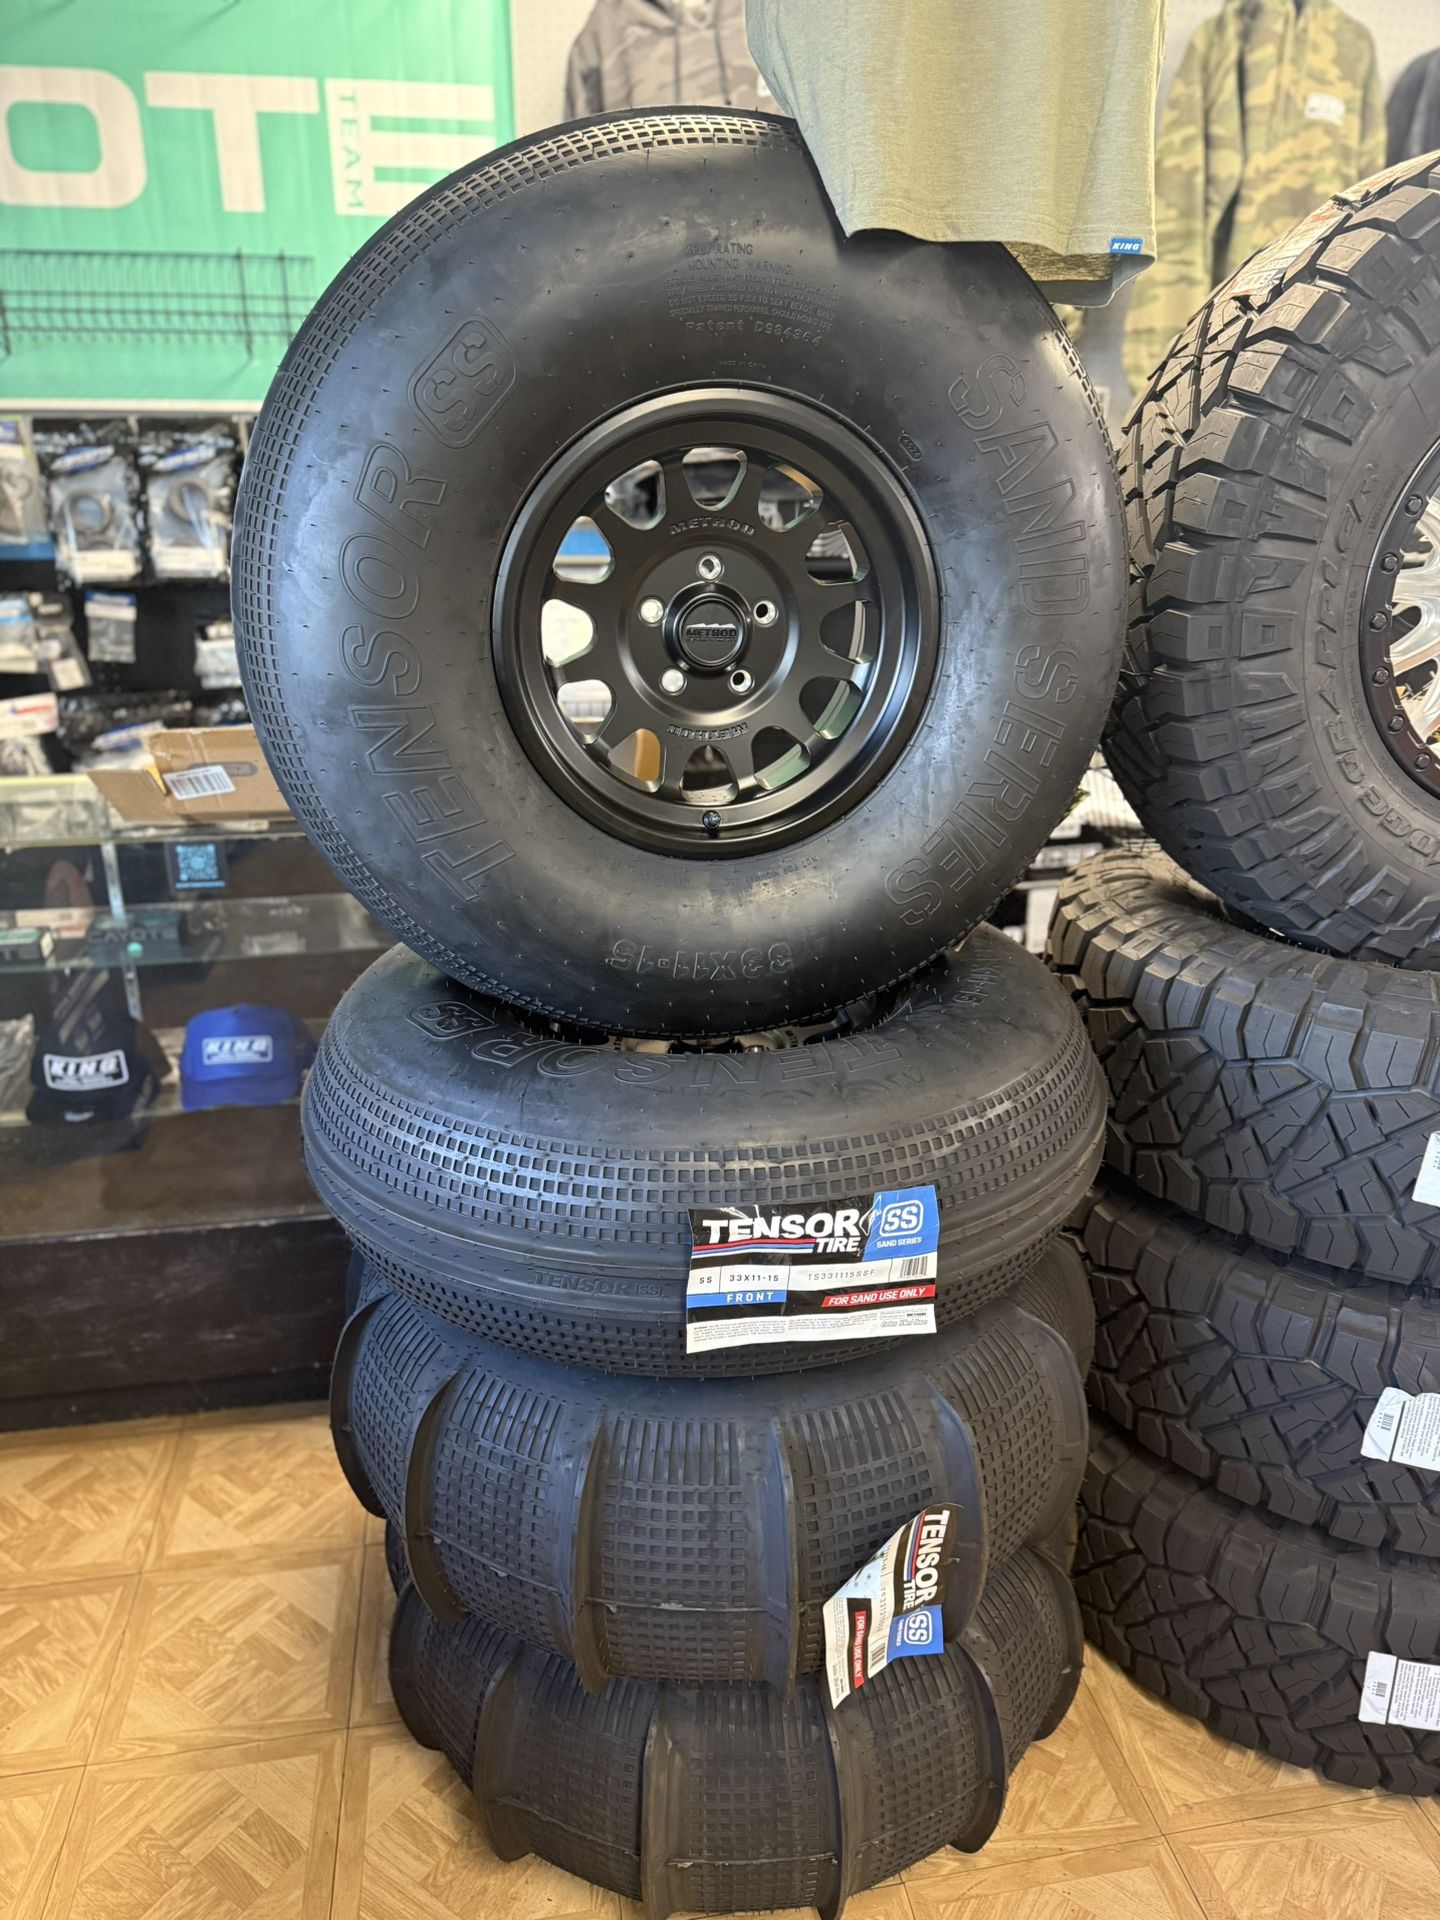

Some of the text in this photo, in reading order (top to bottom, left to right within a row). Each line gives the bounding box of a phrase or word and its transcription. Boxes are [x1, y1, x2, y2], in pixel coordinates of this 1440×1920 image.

[337, 87, 364, 210] TEAM
[715, 241, 753, 255] RATING
[1111, 242, 1140, 251] KING
[688, 258, 740, 271] MOUNTING
[669, 517, 756, 536] METHOD
[338, 332, 516, 903] TENSOR SS
[685, 628, 737, 638] METHOD
[884, 352, 1091, 927] SAND SERIES
[667, 722, 751, 741] METHOD
[782, 863, 799, 875] FOR
[801, 855, 818, 868] NOT
[207, 1038, 269, 1052] KING
[49, 1057, 120, 1077] KING
[470, 1030, 905, 1088] TENSOR
[702, 1208, 861, 1244] TENSOR
[883, 1205, 921, 1232] SS
[812, 1236, 860, 1254] TIRE
[876, 1236, 922, 1249] SAND SERIES
[534, 1270, 632, 1297] TENSOR
[699, 1276, 713, 1284] SS
[729, 1274, 780, 1283] 33X11-15
[726, 1291, 774, 1303] FRONT
[829, 1287, 926, 1306] FOR SAND USE ONLY
[914, 1509, 951, 1607] TENSOR
[902, 1579, 916, 1612] TIRE
[856, 1615, 866, 1630] FOR
[908, 1613, 928, 1642] SS
